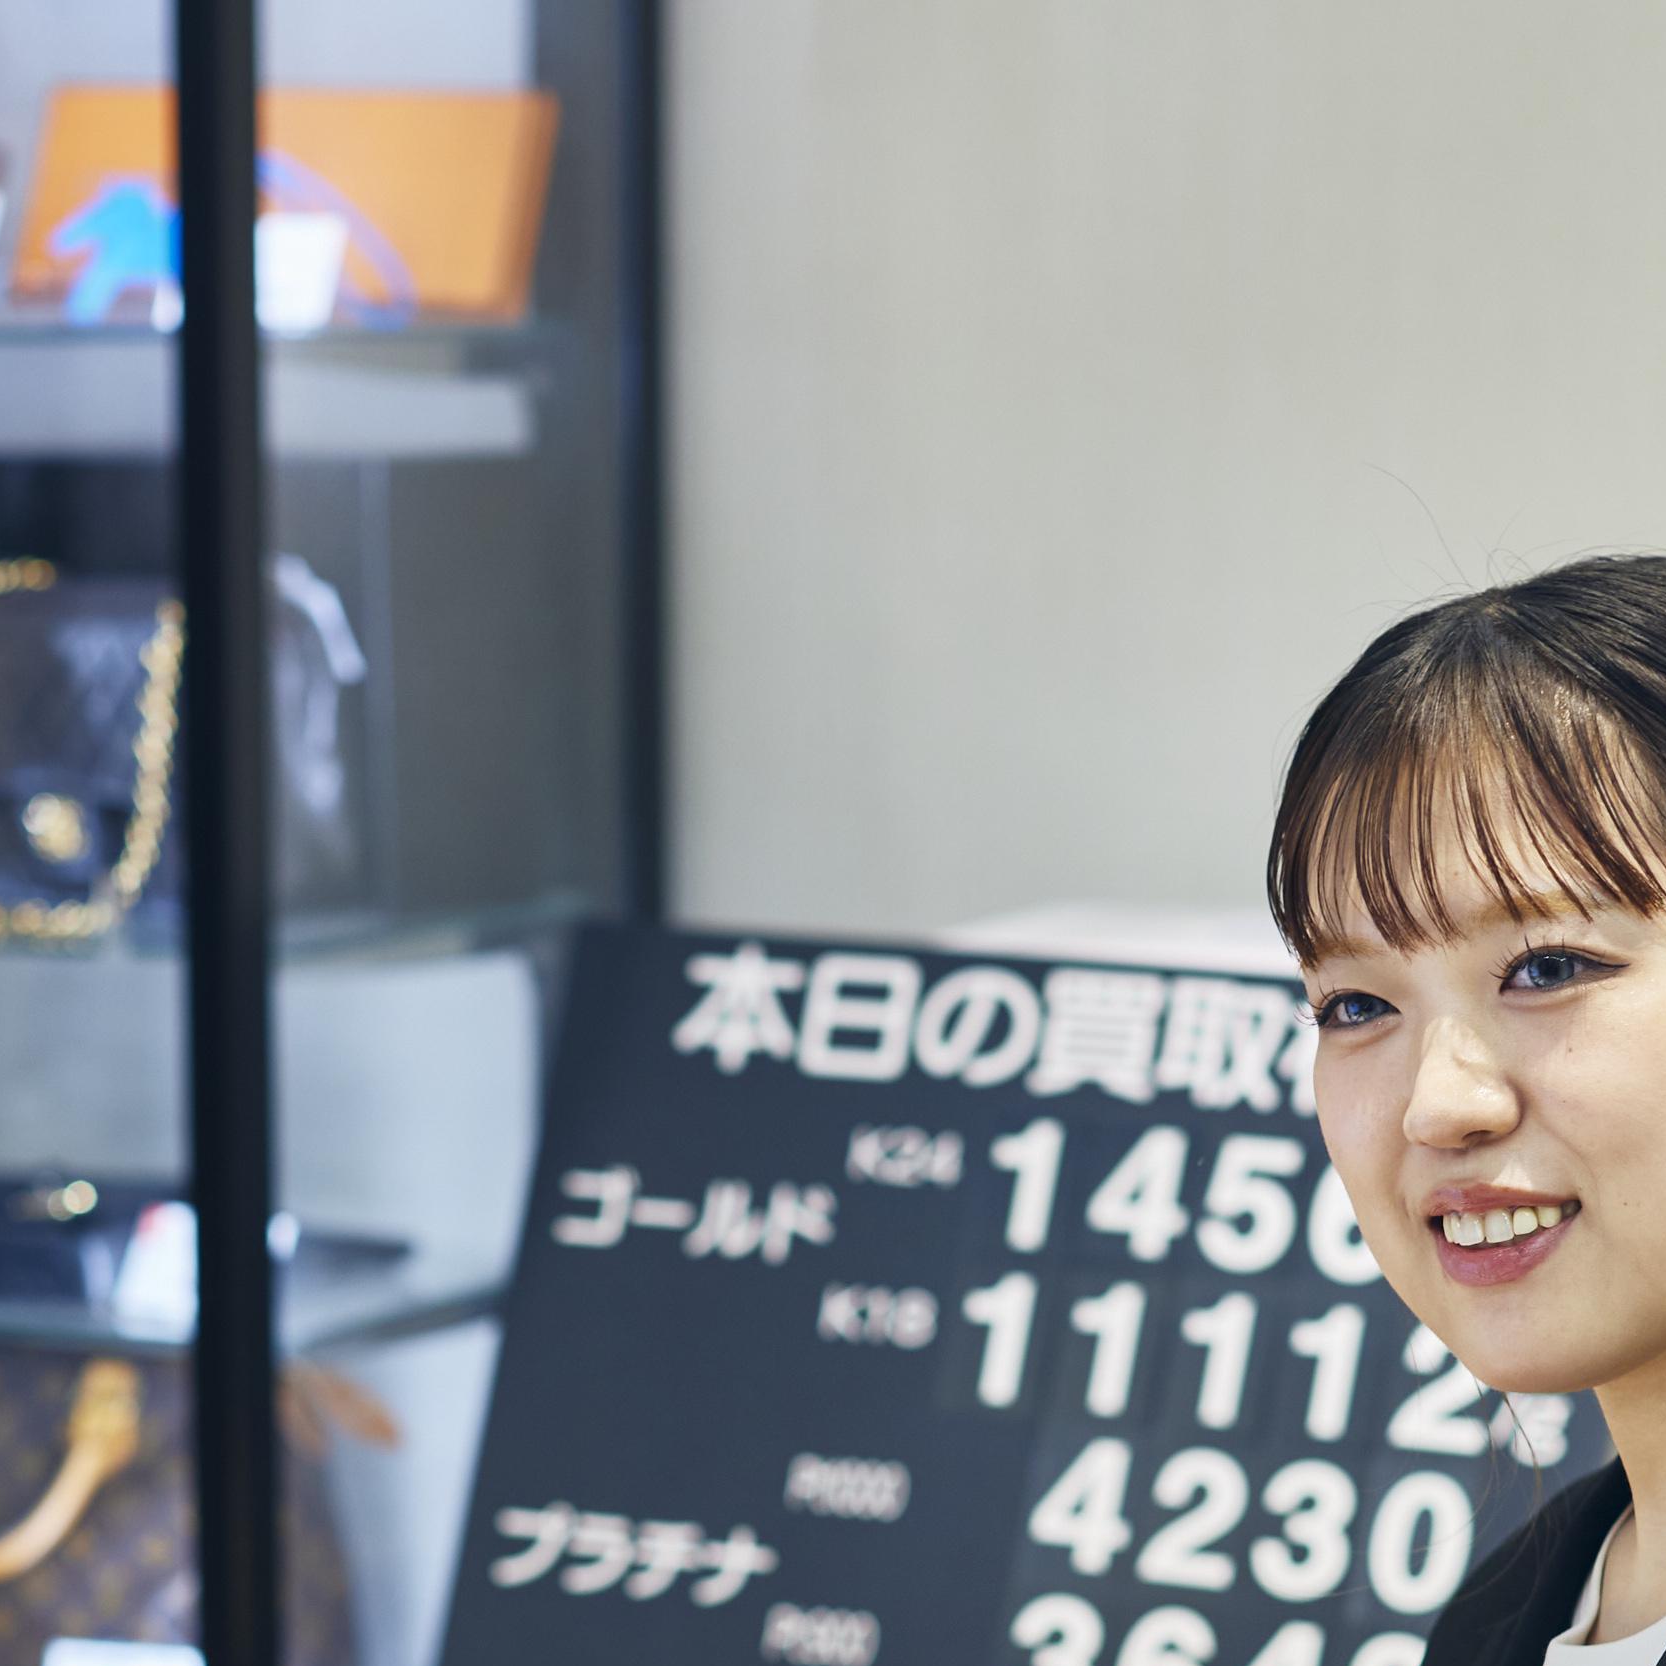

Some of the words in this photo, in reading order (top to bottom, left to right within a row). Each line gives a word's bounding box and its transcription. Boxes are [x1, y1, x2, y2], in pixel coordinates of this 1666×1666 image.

[846, 1126, 965, 1188] K24
[553, 1165, 837, 1264] ゴールド
[817, 1286, 938, 1349] K18
[963, 1270, 1490, 1457] 11112
[490, 1502, 778, 1607] プラチナ
[1028, 1436, 1475, 1615] 4230
